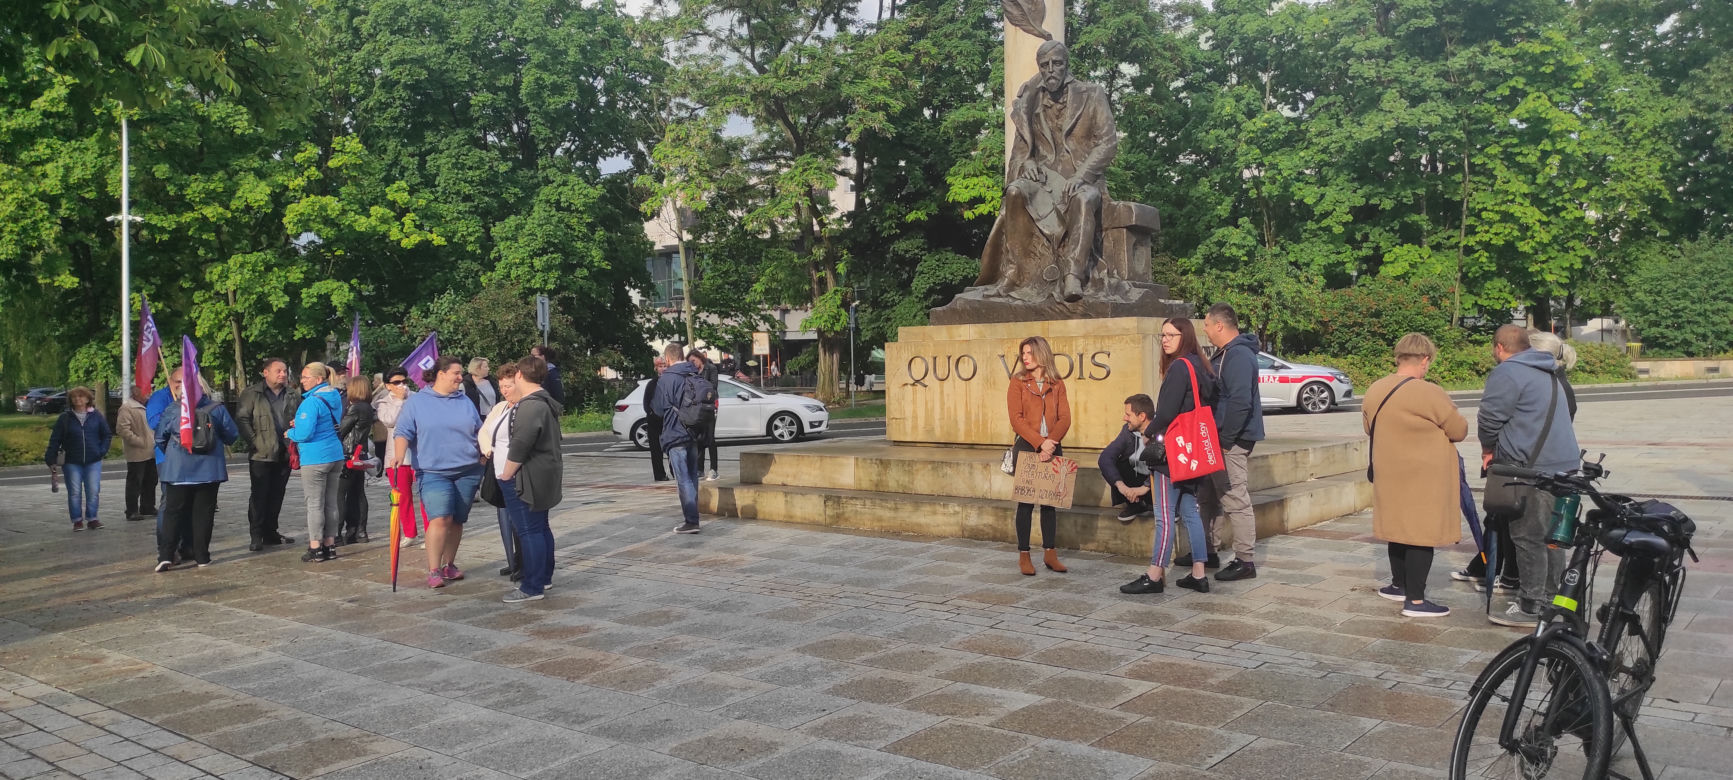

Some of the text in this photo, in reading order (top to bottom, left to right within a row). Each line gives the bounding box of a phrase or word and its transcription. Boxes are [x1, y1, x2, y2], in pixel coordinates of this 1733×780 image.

[903, 351, 1111, 388] QUO VDIS
[1199, 422, 1215, 465] dental day
